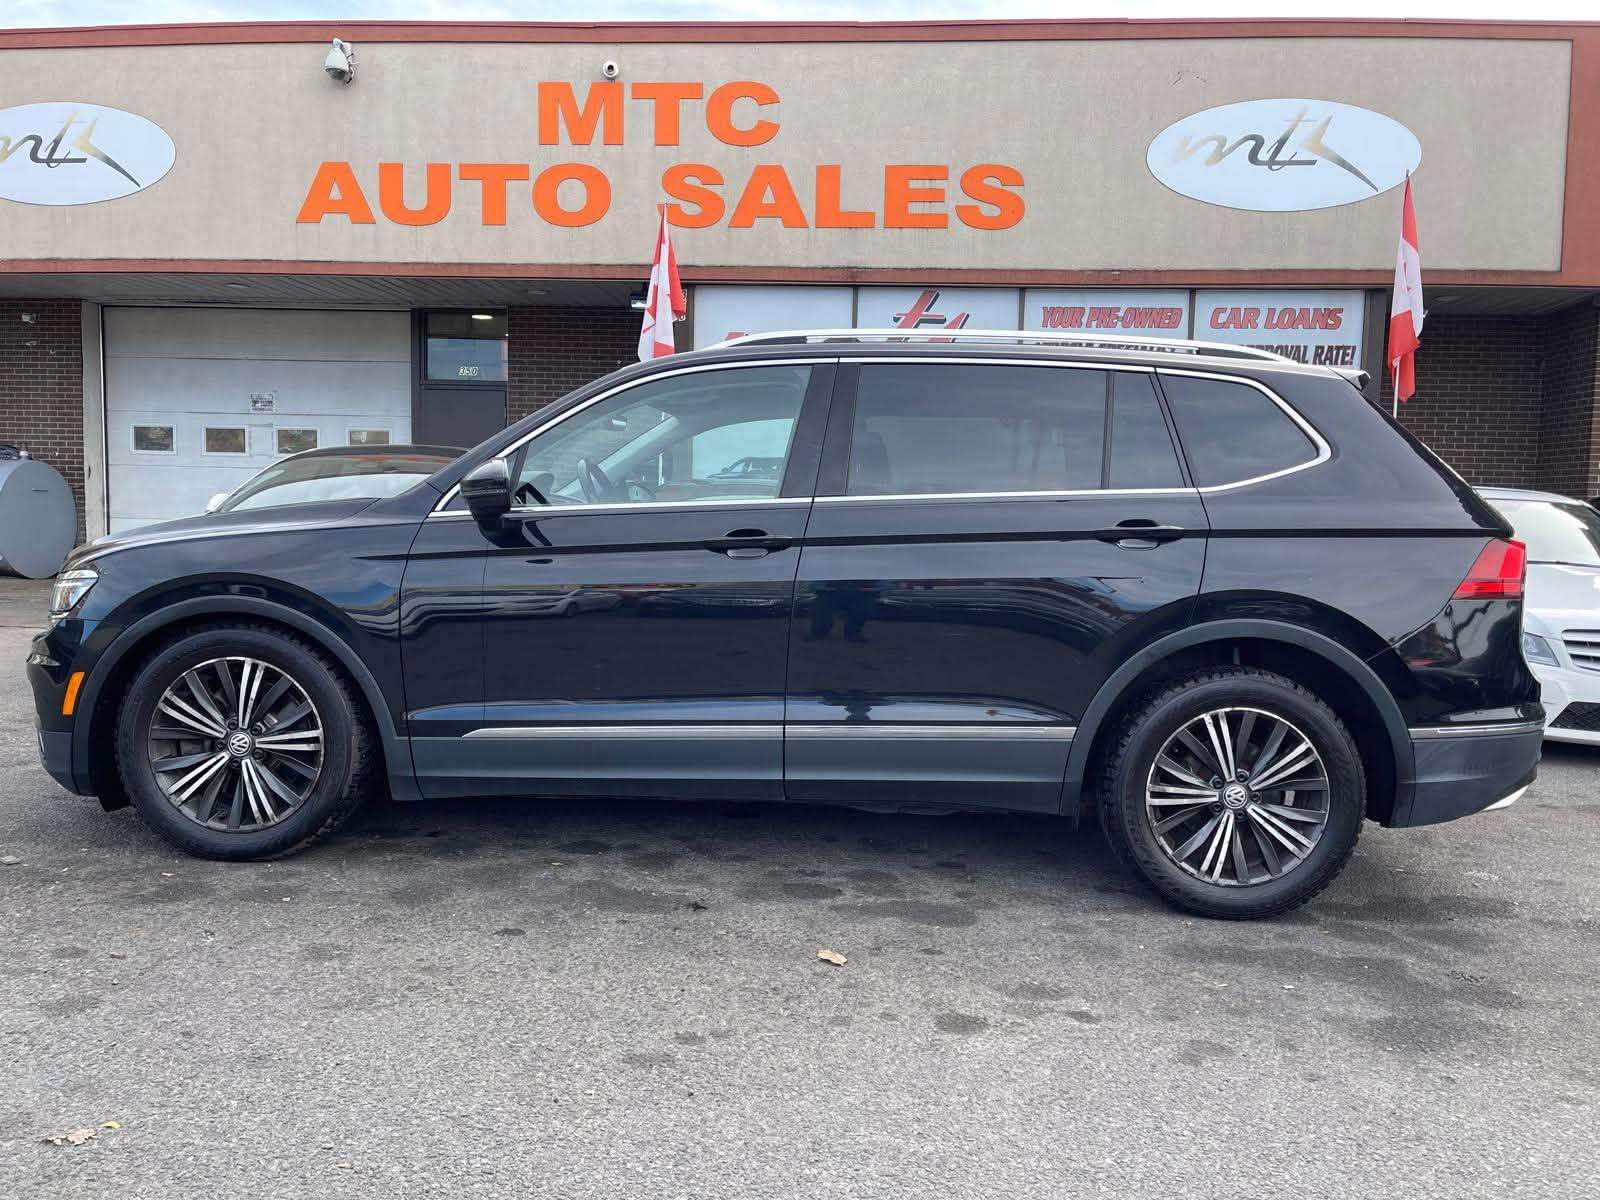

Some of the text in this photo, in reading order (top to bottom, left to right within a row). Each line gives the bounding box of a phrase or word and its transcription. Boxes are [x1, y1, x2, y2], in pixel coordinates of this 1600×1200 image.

[537, 81, 780, 147] MTC
[296, 161, 1026, 231] AUTO SALES
[1040, 306, 1183, 329] YOUR PRE-OWNED
[1210, 307, 1344, 330] CAR LOANS
[1312, 344, 1357, 366] RATE!
